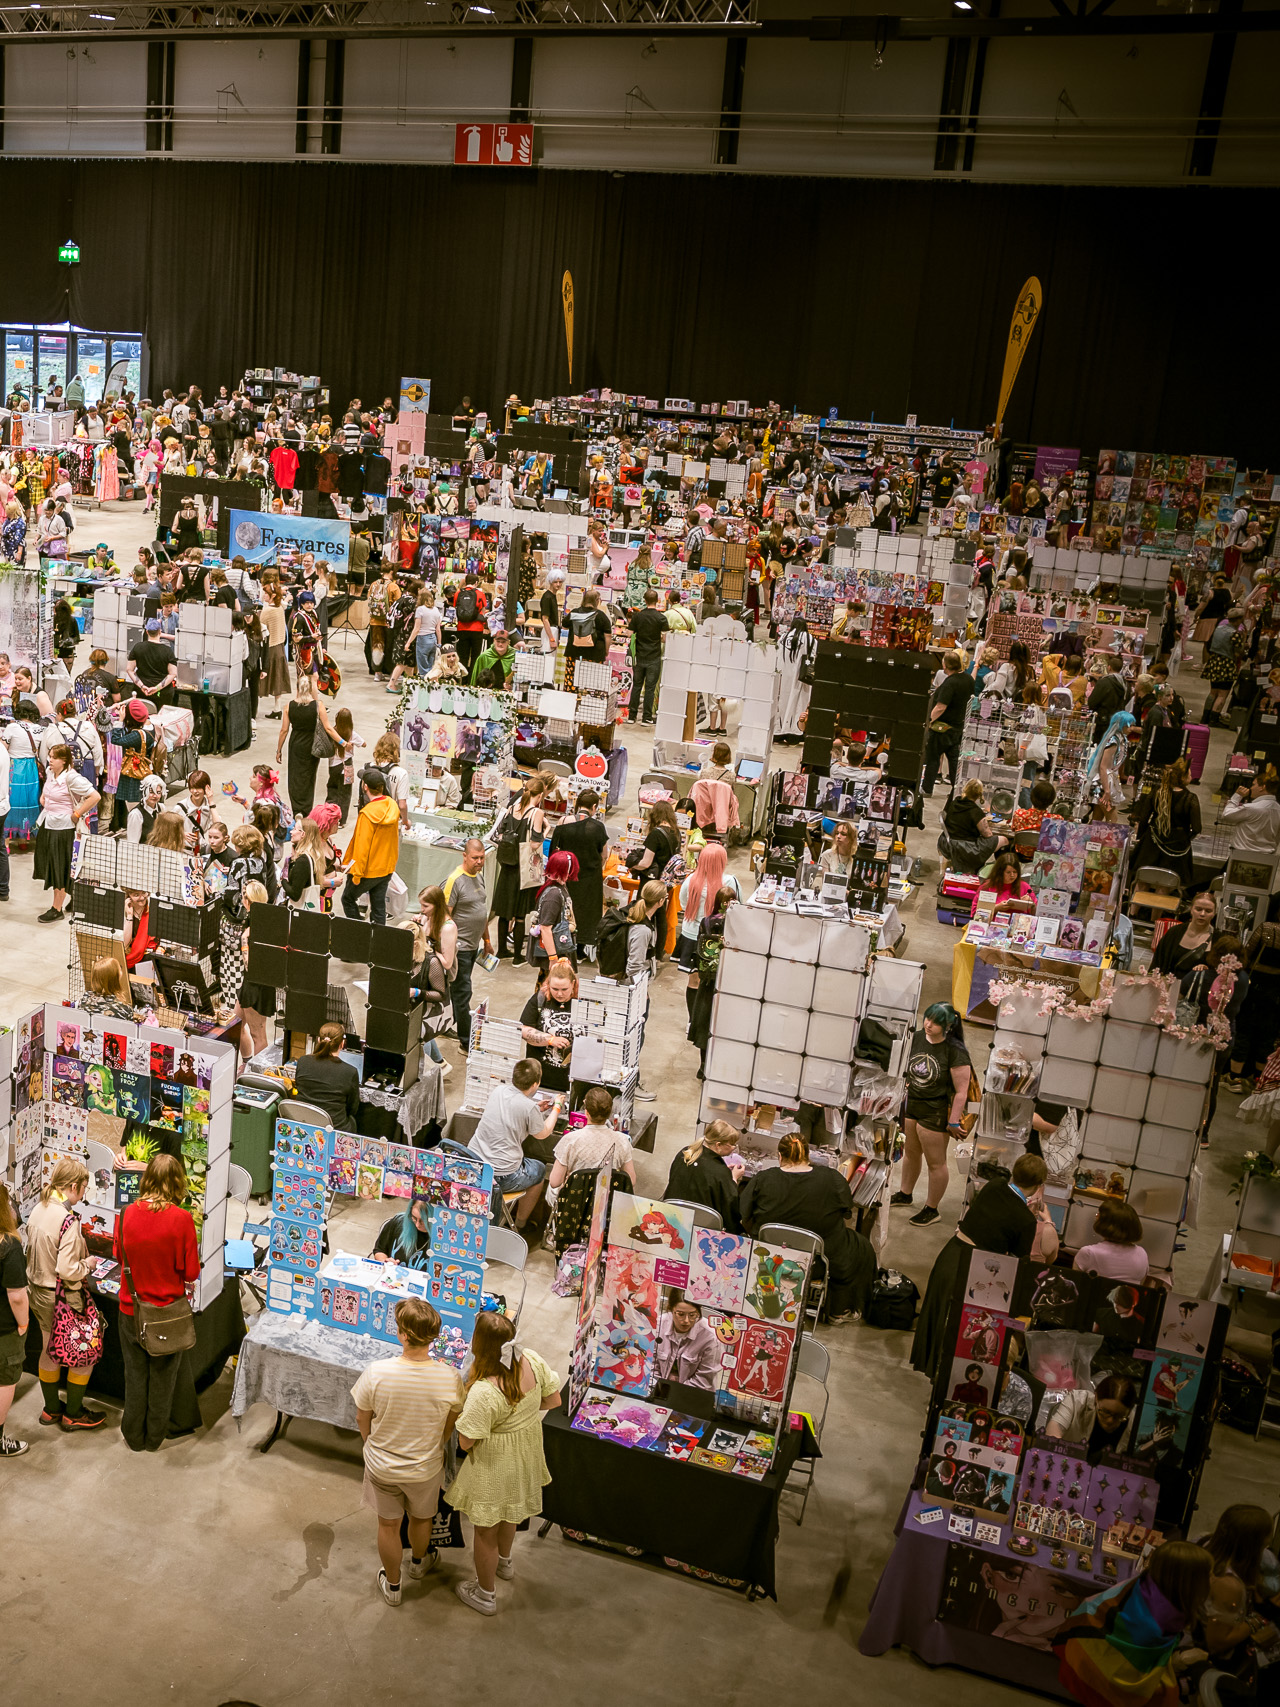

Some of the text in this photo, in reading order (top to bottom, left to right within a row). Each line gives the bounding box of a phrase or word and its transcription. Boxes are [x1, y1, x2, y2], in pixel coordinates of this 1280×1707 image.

[260, 527, 345, 556] Fervares
[120, 1073, 138, 1082] CRAZY
[120, 1078, 136, 1087] FROG
